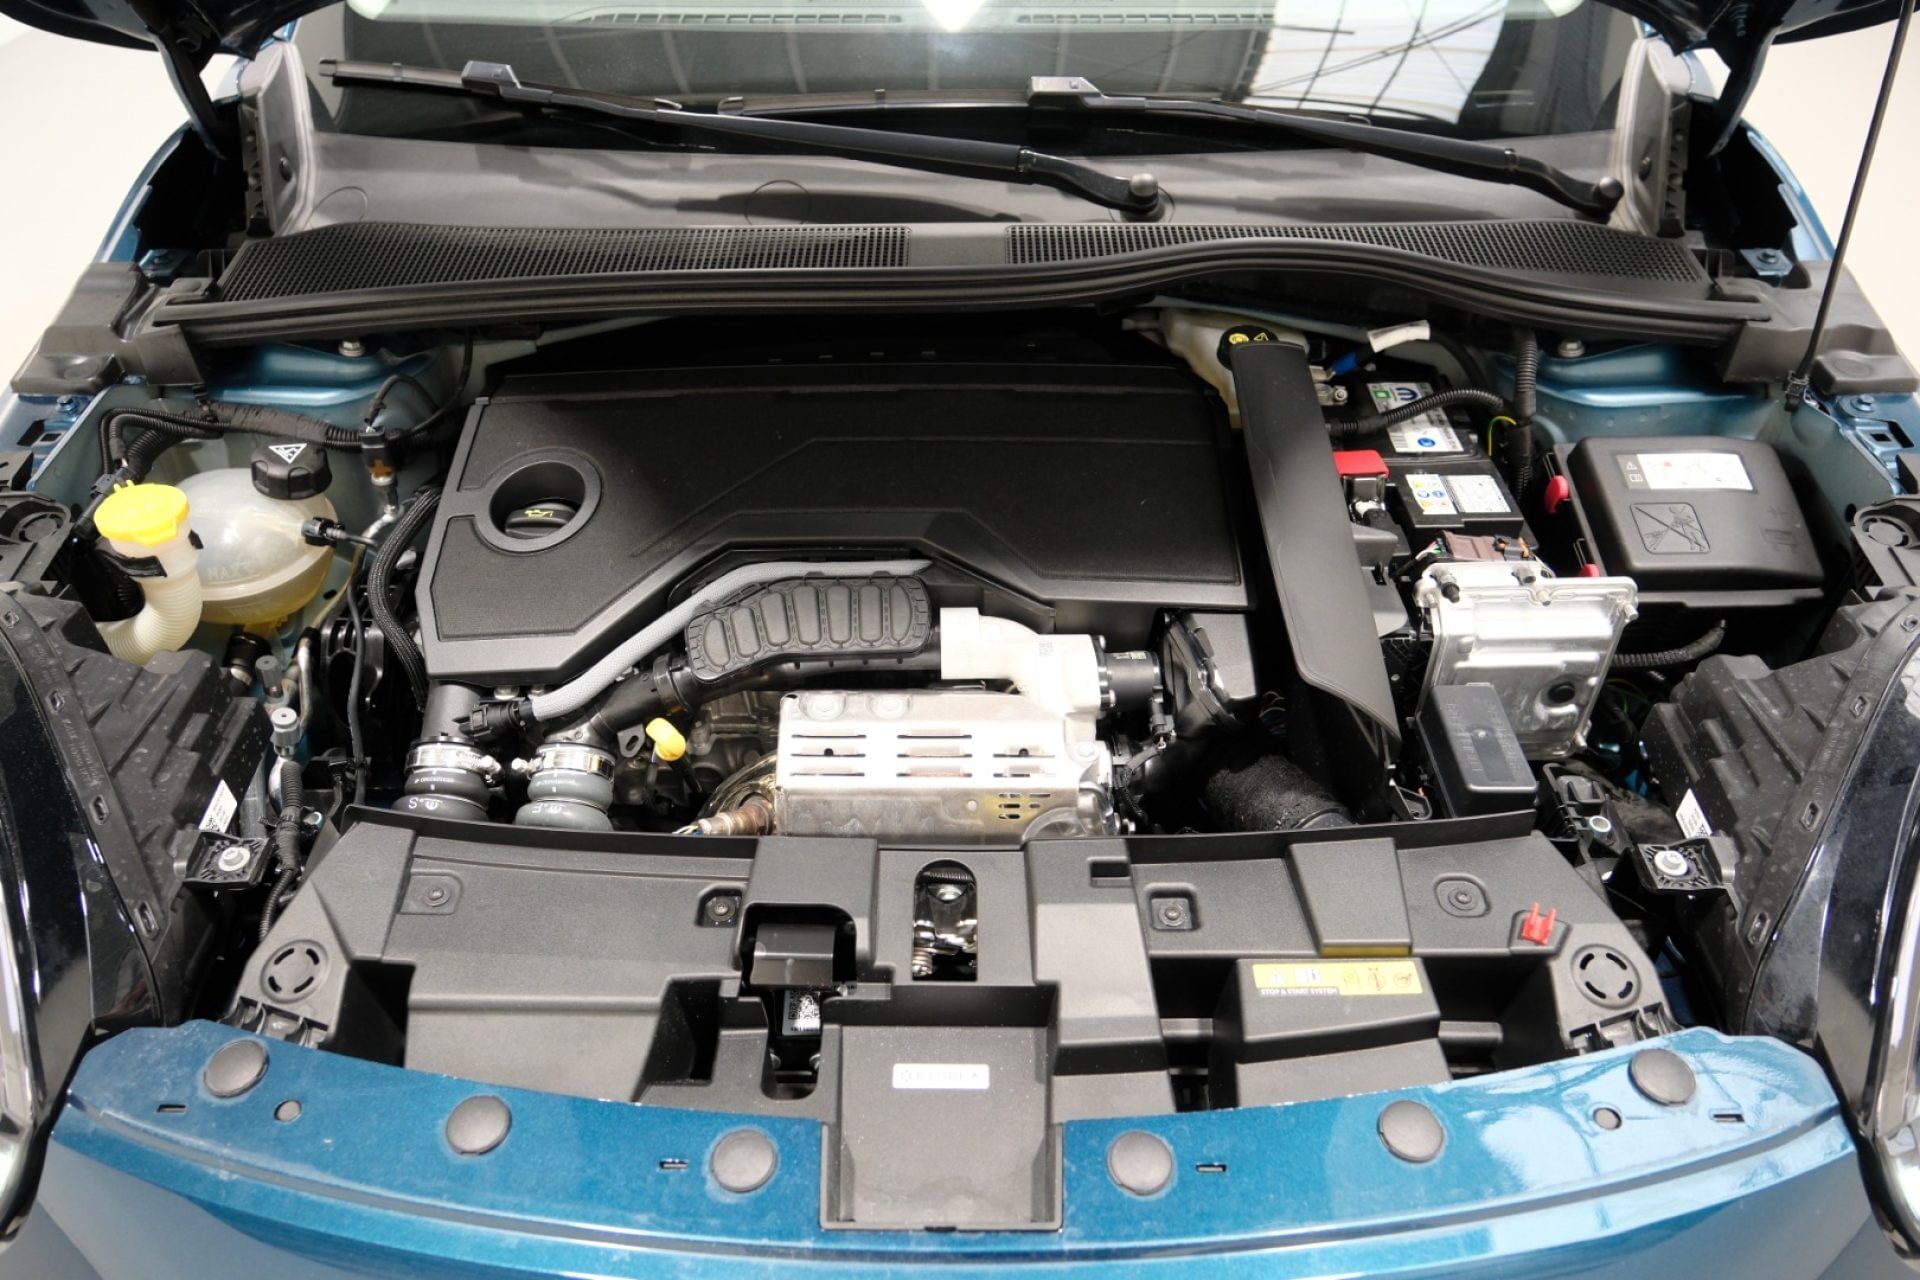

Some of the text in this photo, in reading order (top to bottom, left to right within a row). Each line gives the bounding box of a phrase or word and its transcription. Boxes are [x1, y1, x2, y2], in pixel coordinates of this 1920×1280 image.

[1260, 988, 1280, 996] STOP
[1287, 988, 1309, 996] START
[1311, 987, 1338, 996] SYSTEM
